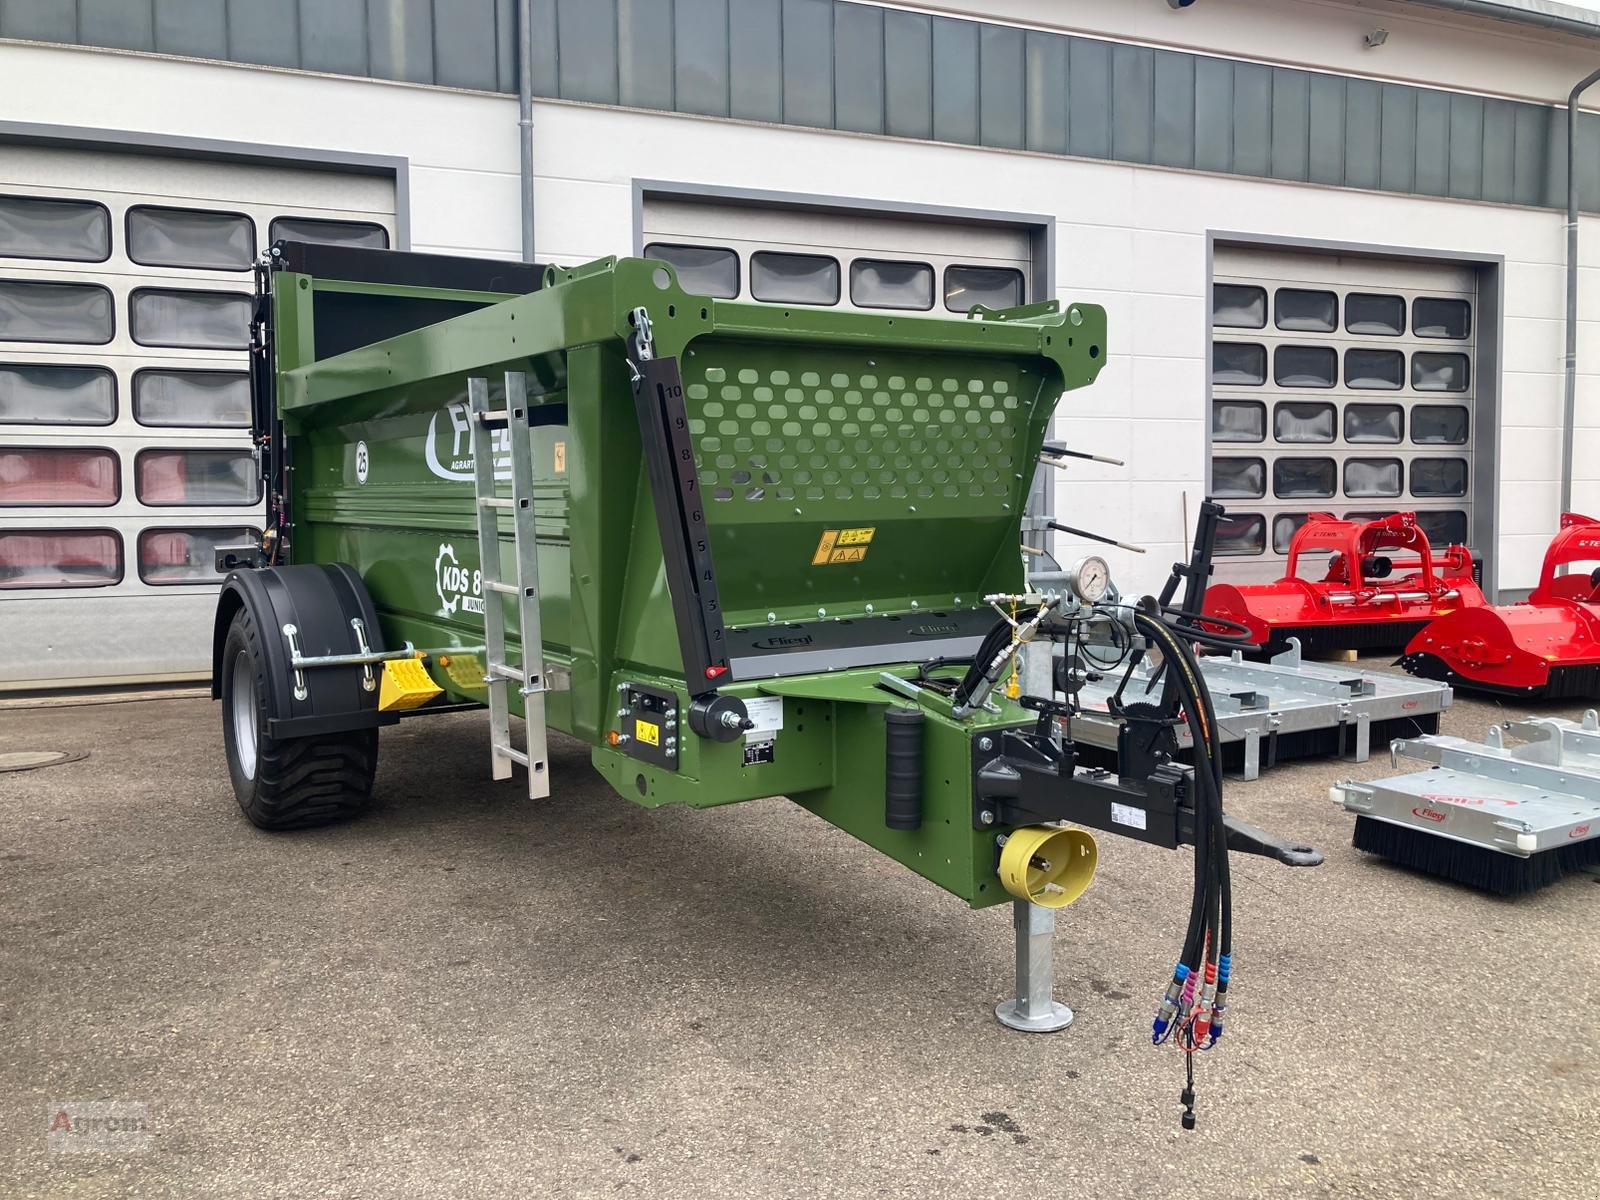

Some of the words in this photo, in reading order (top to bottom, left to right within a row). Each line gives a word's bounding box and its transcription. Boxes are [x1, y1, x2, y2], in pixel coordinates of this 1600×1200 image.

[665, 385, 682, 399] 10
[675, 417, 685, 430] 9
[681, 448, 691, 461] 8
[358, 452, 367, 474] 25
[687, 479, 694, 492] 7
[692, 510, 701, 522] 6
[697, 540, 706, 552] 5
[443, 566, 469, 593] KDS
[703, 569, 713, 581] 4
[707, 599, 717, 612] 3
[713, 629, 722, 641] 2
[767, 635, 814, 647] Fliegl
[1421, 807, 1447, 823] Fliegl
